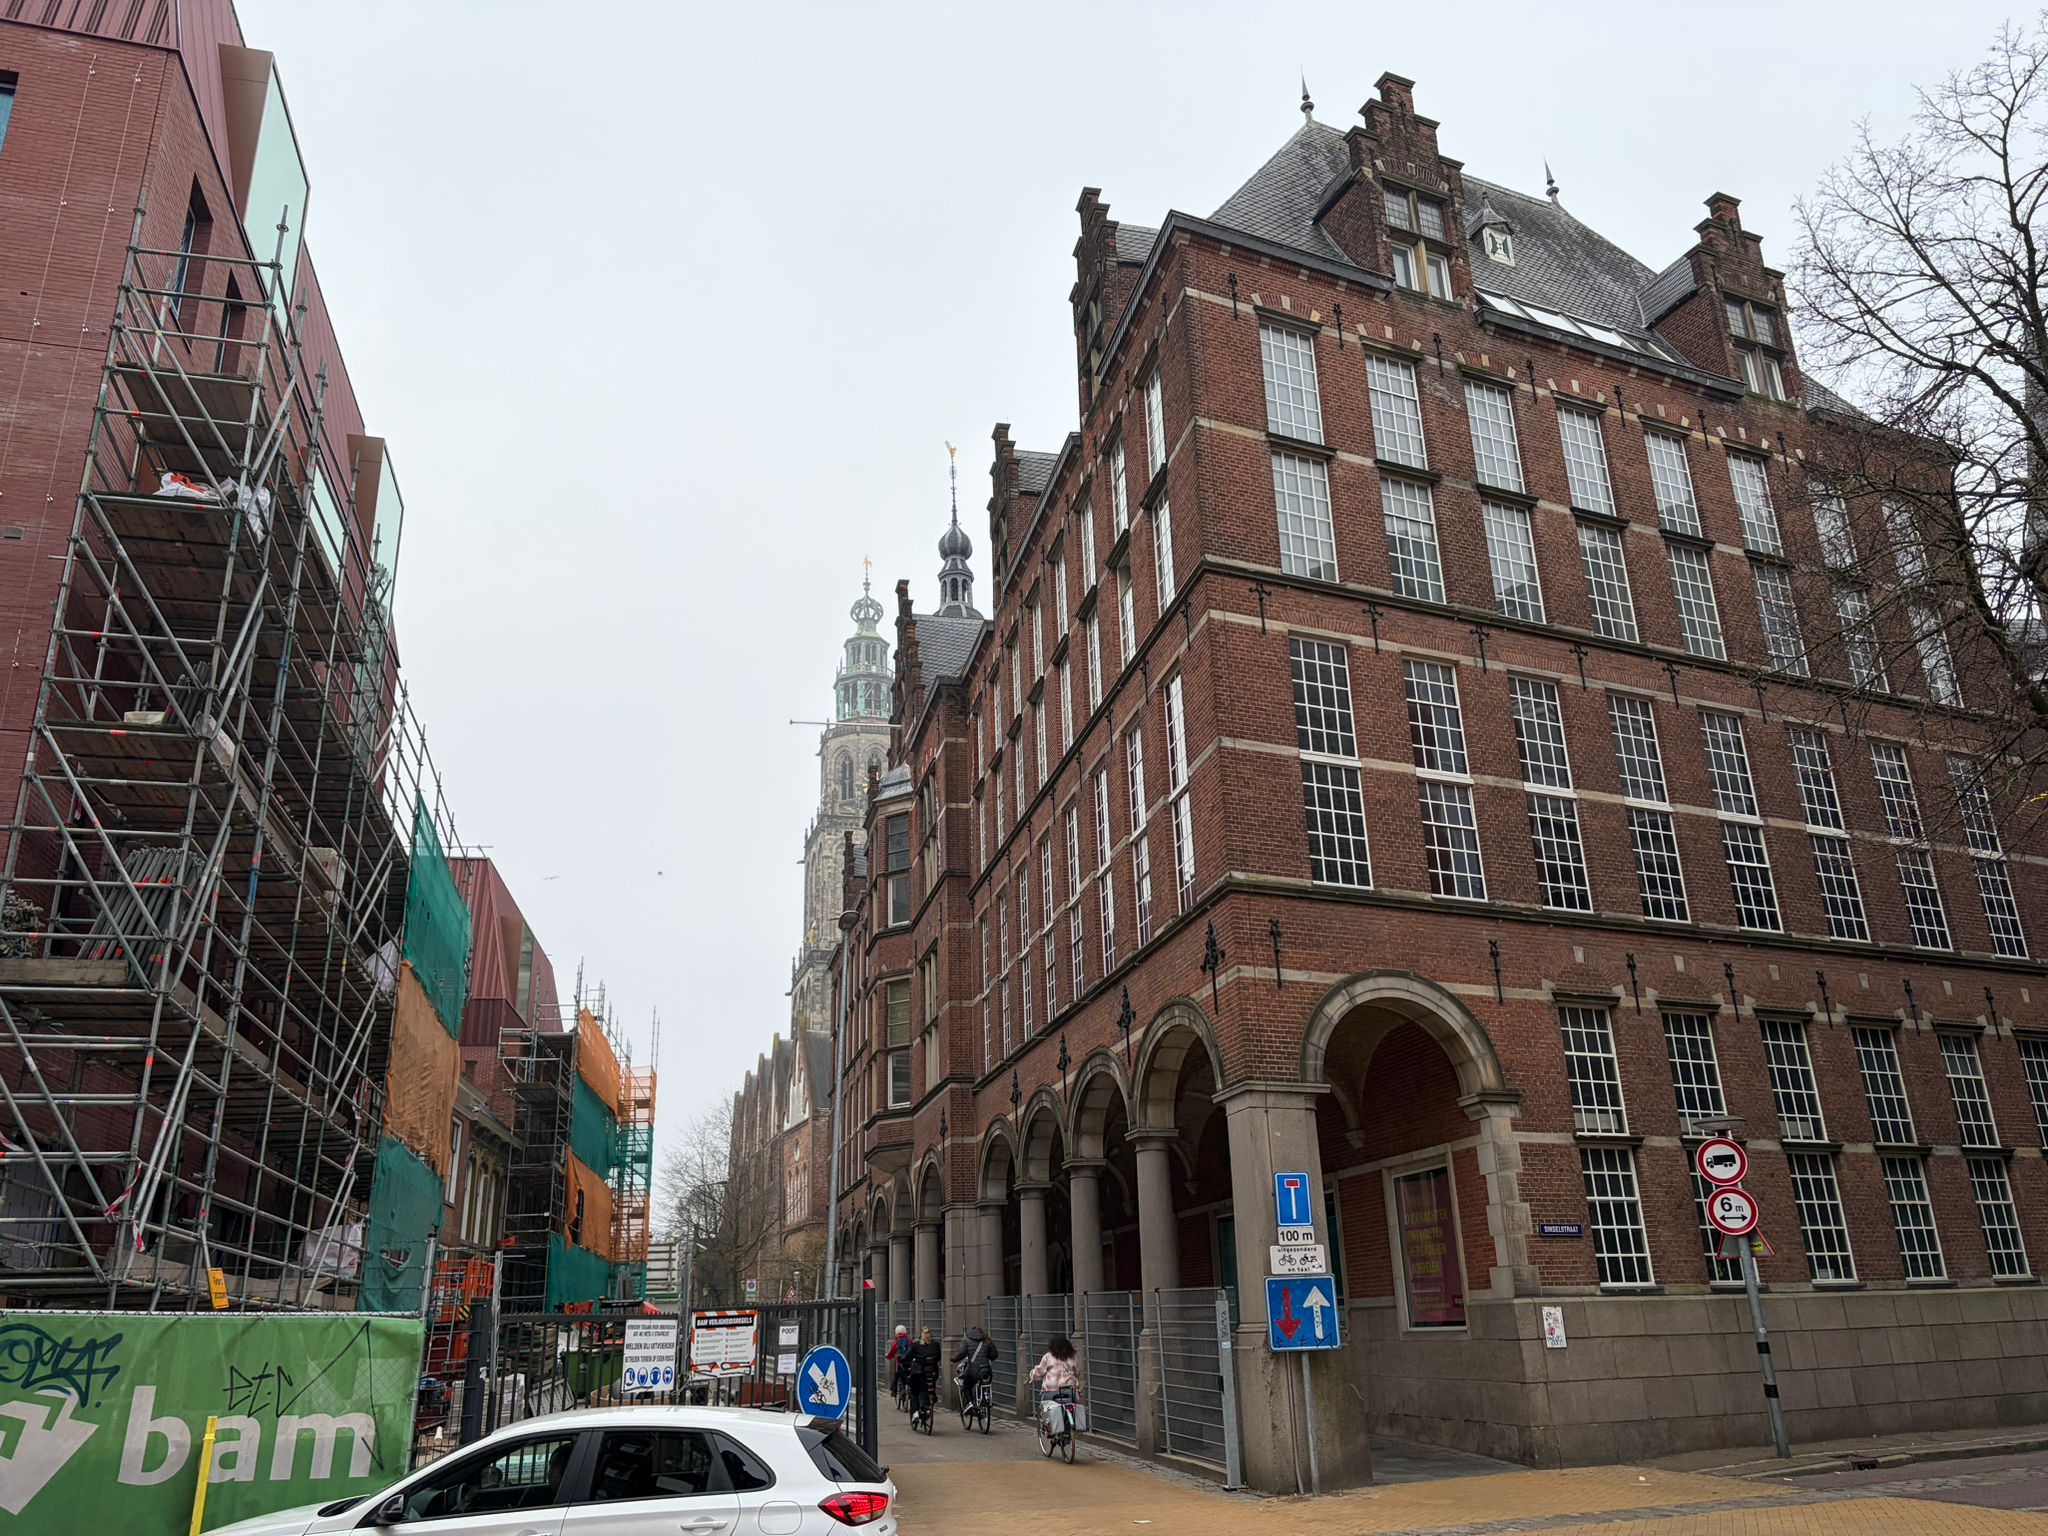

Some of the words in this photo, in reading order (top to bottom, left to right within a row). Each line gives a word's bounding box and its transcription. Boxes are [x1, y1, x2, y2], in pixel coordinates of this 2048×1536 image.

[1720, 1196, 1733, 1212] 6
[1280, 1230, 1299, 1242] 100
[1302, 1232, 1313, 1241] m
[651, 1342, 675, 1350] UITVOERDER
[117, 1385, 376, 1486] bam
